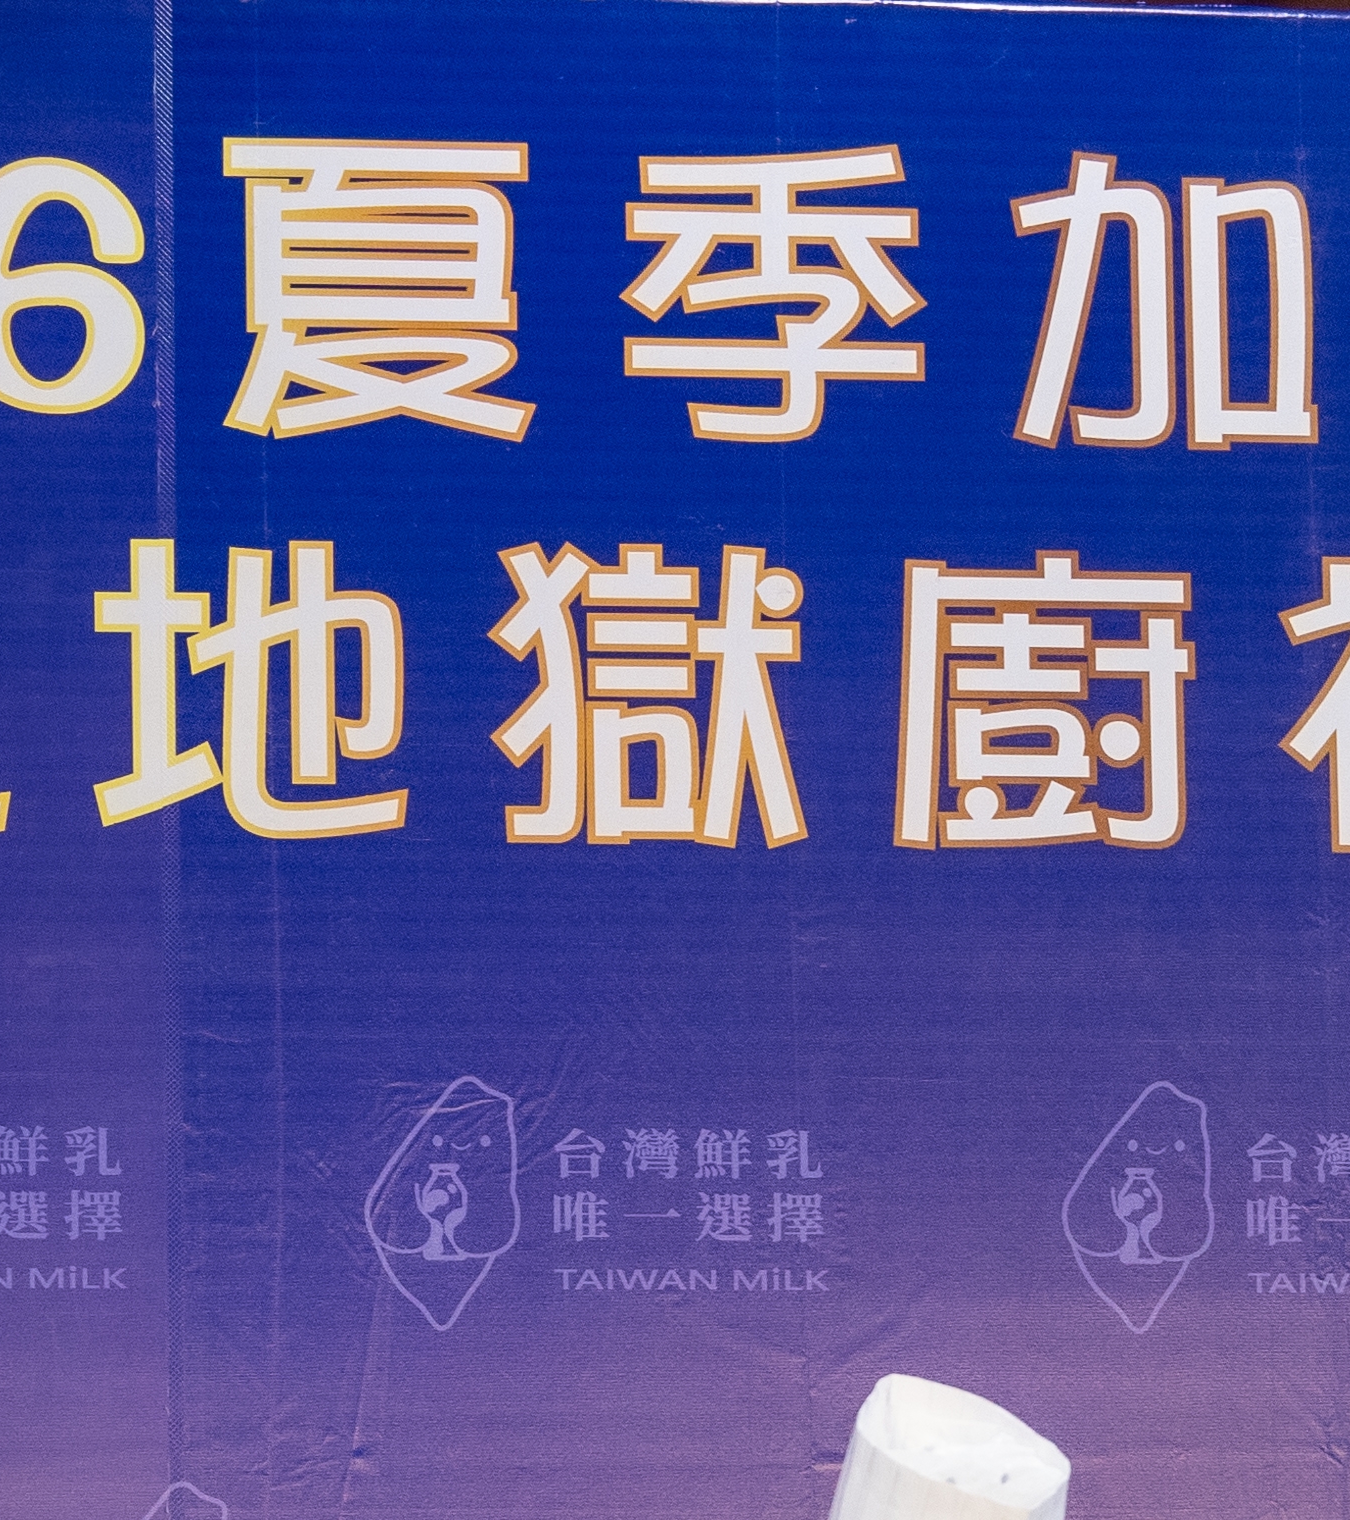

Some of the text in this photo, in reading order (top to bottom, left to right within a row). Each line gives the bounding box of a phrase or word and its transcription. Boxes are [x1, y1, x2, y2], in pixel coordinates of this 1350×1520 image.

[553, 1128, 824, 1180] 台灣鮮乳
[552, 1191, 825, 1243] 唯一選擇
[28, 1264, 128, 1290] MiLK
[553, 1265, 830, 1292] TAIWAN MiLK
